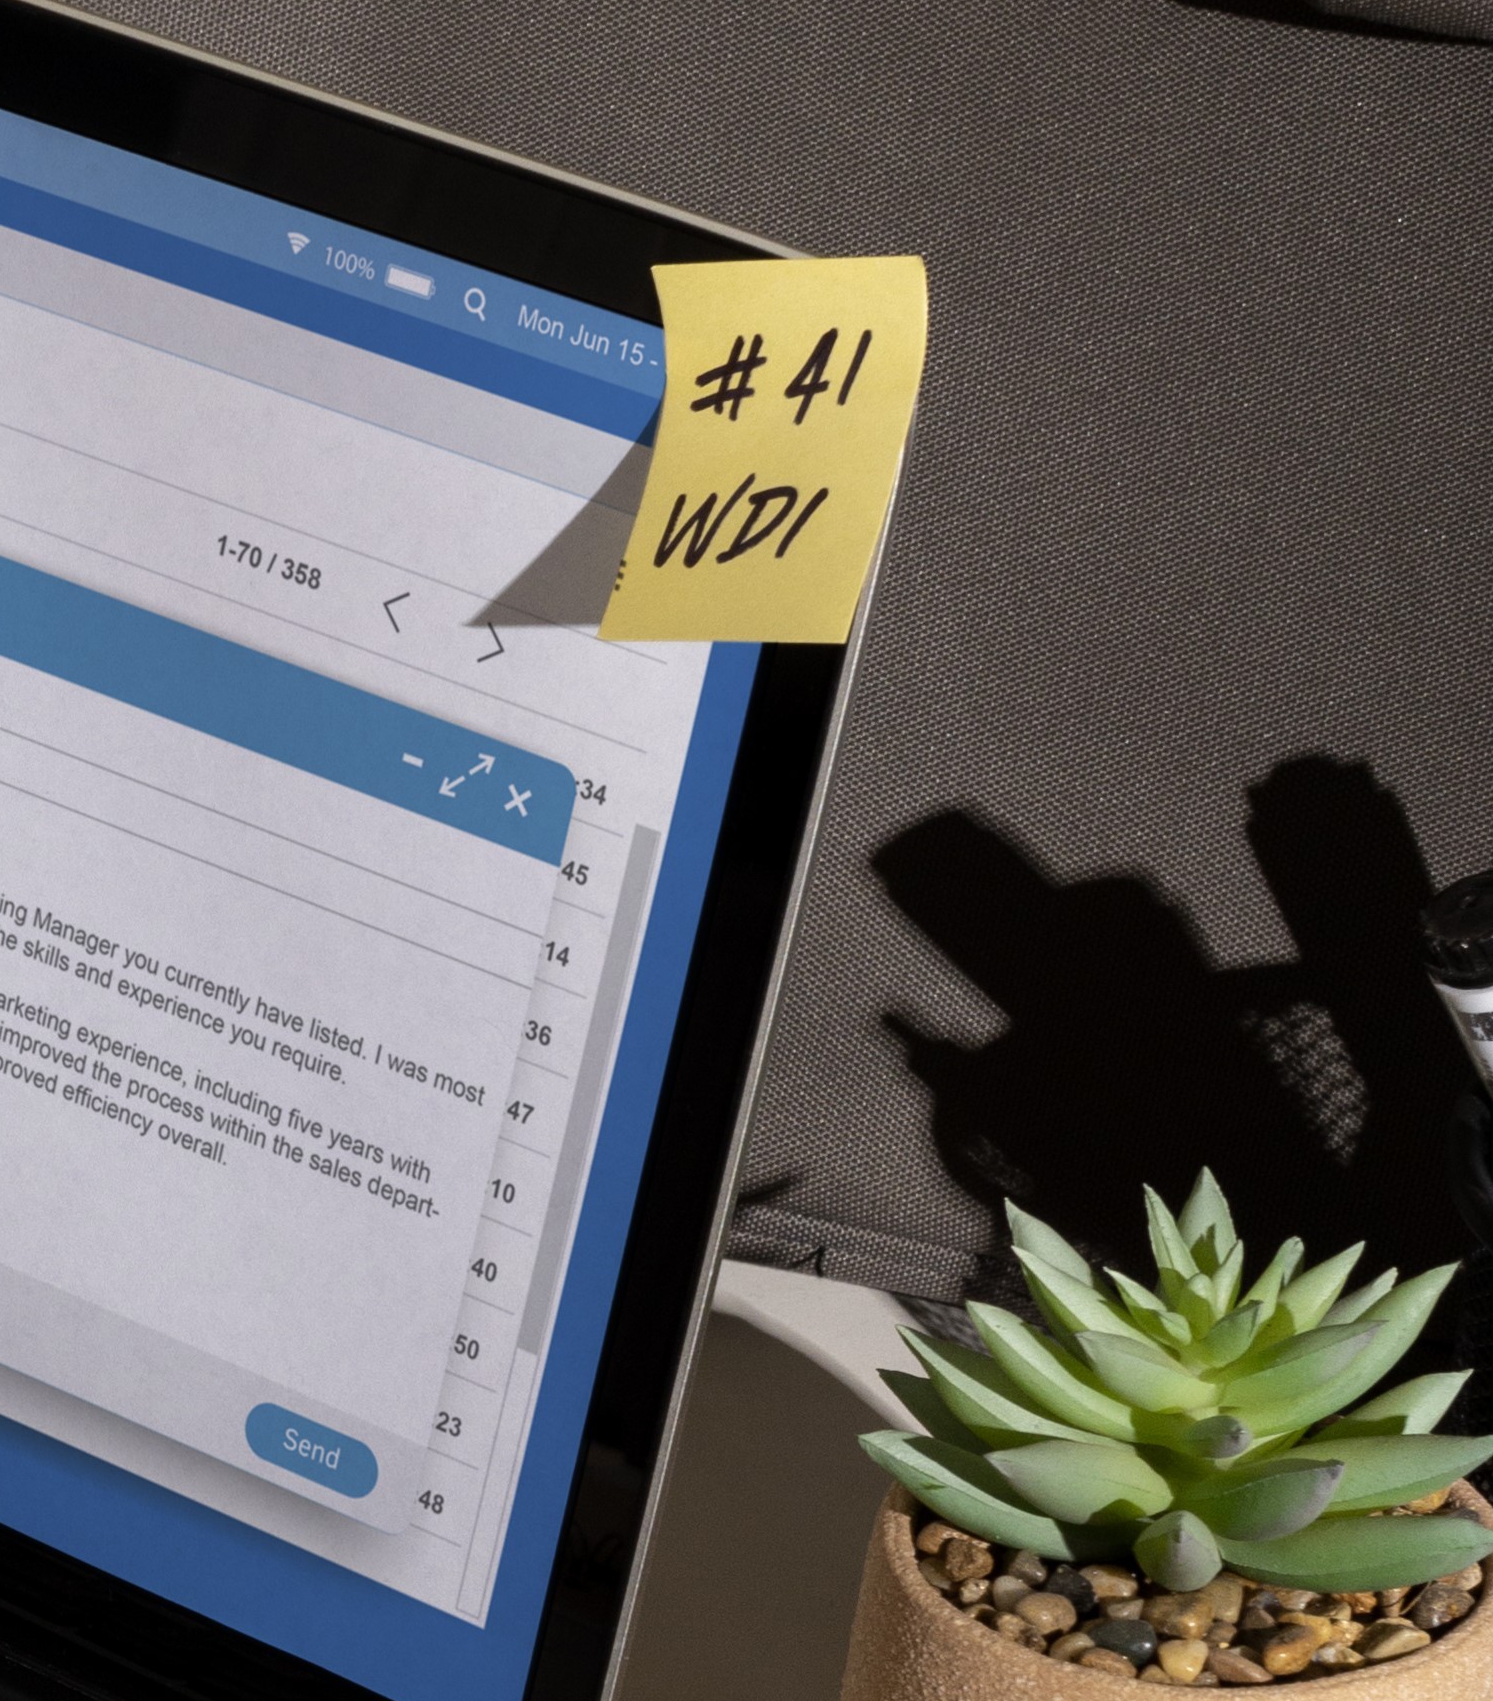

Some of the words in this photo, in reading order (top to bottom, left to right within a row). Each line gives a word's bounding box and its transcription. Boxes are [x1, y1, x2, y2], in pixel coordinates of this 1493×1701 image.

[326, 246, 375, 280] 100%
[518, 305, 564, 339] Mon
[570, 324, 610, 355] Jun
[619, 339, 645, 365] 15
[690, 334, 767, 421] #
[784, 328, 872, 425] 41
[218, 535, 262, 568] 1-70
[281, 558, 321, 590] 358
[23, 940, 69, 971] skills
[75, 962, 113, 989] and
[118, 979, 225, 1034] experience
[229, 1024, 266, 1051] you
[271, 1041, 345, 1085] require.
[33, 907, 120, 958] Manager
[123, 949, 159, 975] you
[165, 965, 250, 1014] currently
[255, 996, 304, 1032] have
[309, 1018, 366, 1060] listed.
[375, 1044, 382, 1064] I
[388, 1054, 428, 1083] was
[433, 1073, 485, 1106] most
[62, 1084, 153, 1137] efficiency
[158, 1124, 226, 1165] overall.
[77, 1027, 186, 1087] experience,
[194, 1070, 282, 1127] including
[288, 1108, 323, 1139] five
[327, 1129, 384, 1164] years
[391, 1154, 431, 1183] with
[284, 1428, 340, 1469] Send
